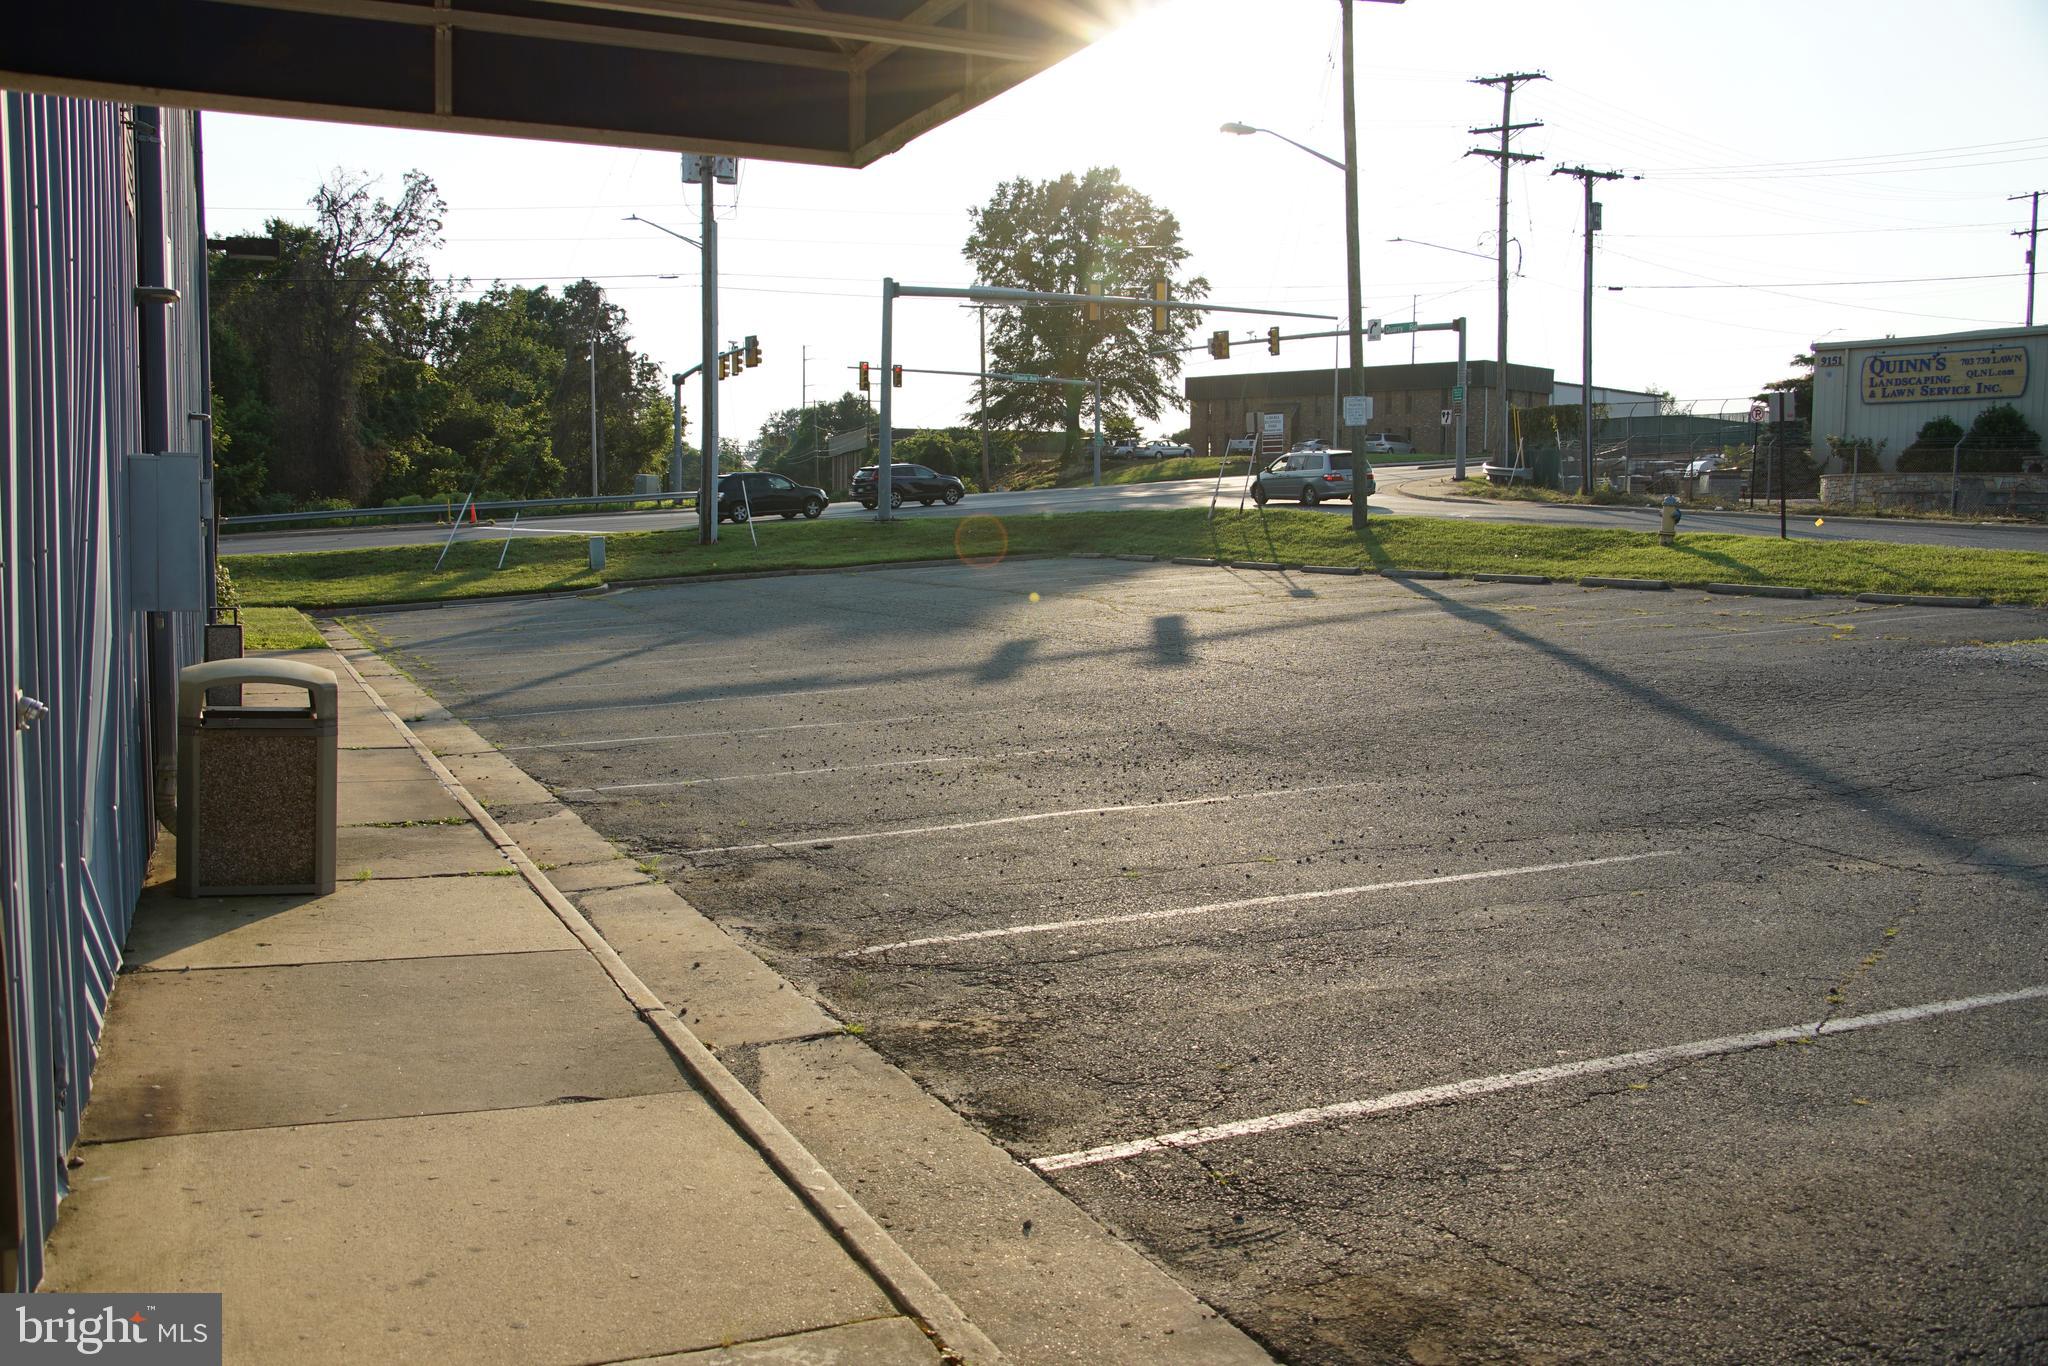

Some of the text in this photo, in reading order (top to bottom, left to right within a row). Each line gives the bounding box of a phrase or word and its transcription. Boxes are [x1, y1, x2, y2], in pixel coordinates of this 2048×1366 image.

[1820, 356, 1842, 366] 9151
[1870, 353, 1946, 377] QUINN'S
[1966, 368, 2014, 378] QLNL.com
[1869, 375, 1951, 388] LANDSCAPING
[1869, 382, 2002, 398] & LAWN SERVICE INC.
